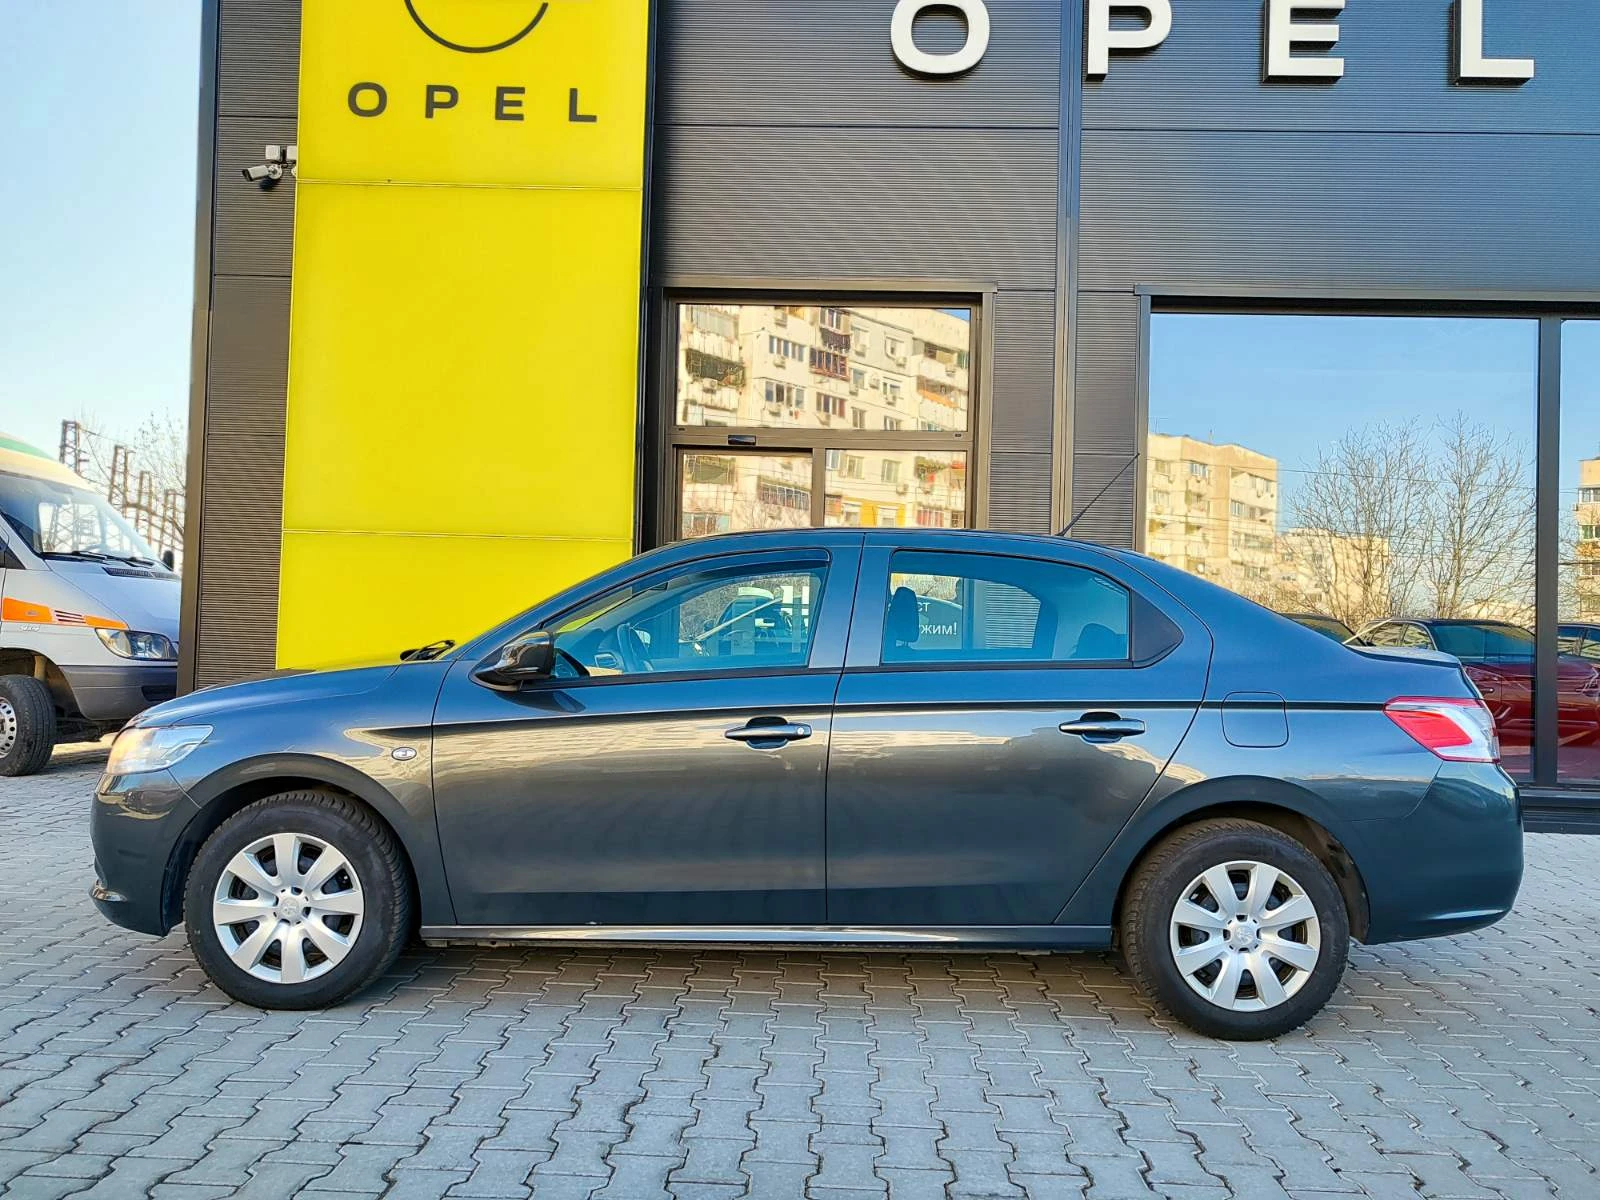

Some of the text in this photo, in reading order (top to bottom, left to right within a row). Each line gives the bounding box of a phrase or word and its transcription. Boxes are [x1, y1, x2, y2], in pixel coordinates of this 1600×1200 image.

[890, 0, 1535, 84] OPEL
[347, 82, 598, 123] OPEL
[919, 621, 958, 636] жим!
